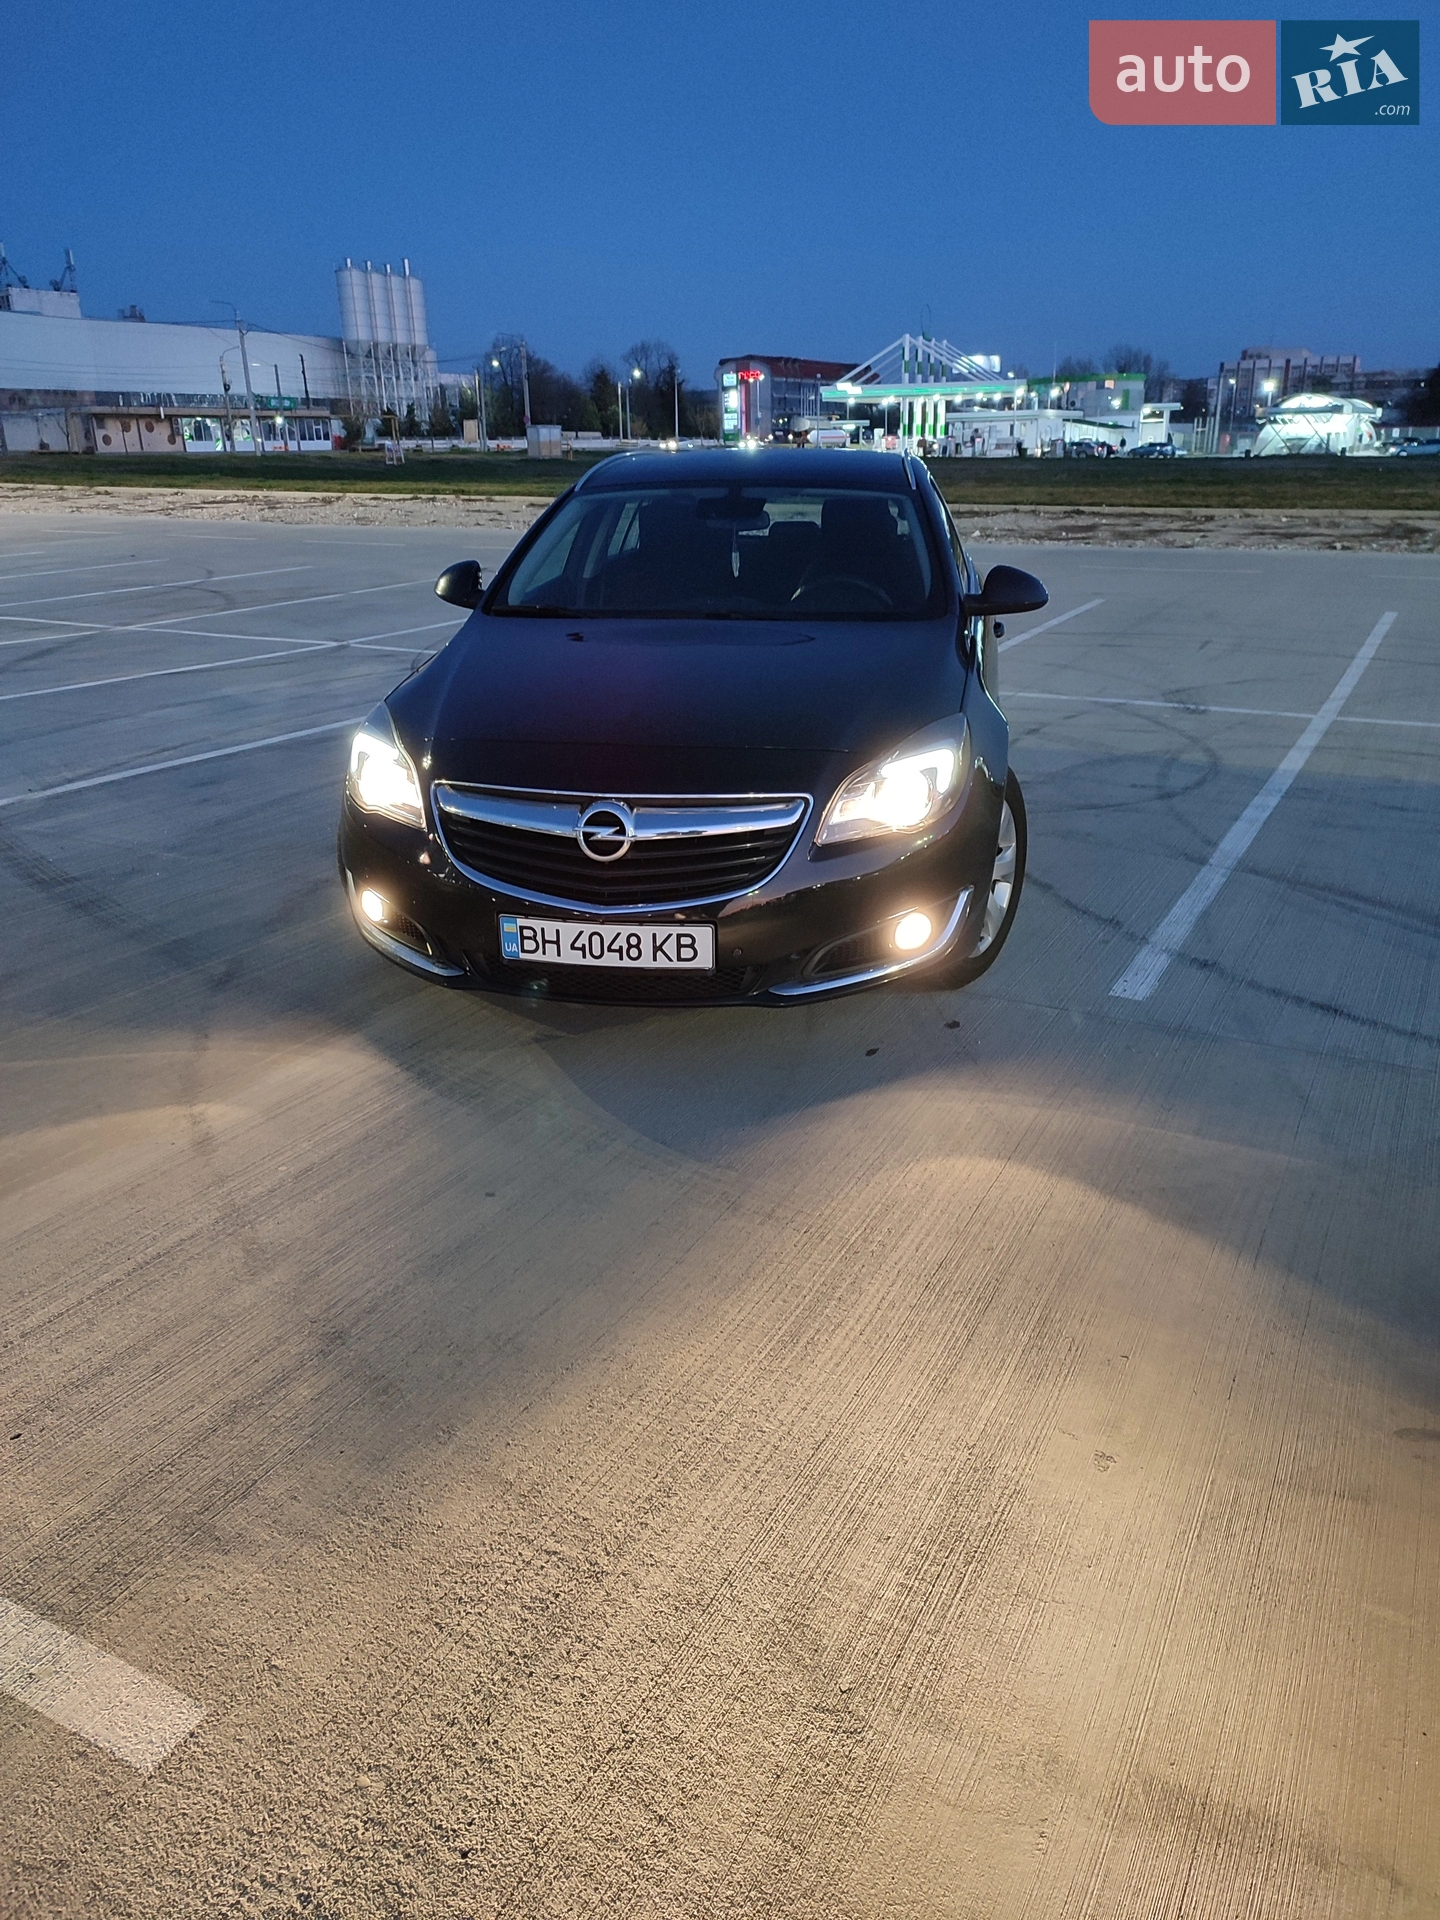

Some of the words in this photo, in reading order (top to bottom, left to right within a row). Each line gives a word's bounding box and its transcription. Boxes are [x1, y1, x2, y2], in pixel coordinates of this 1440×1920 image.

[505, 942, 518, 952] UA
[519, 925, 561, 957] BH
[570, 930, 643, 961] 4048
[652, 932, 698, 962] KB
